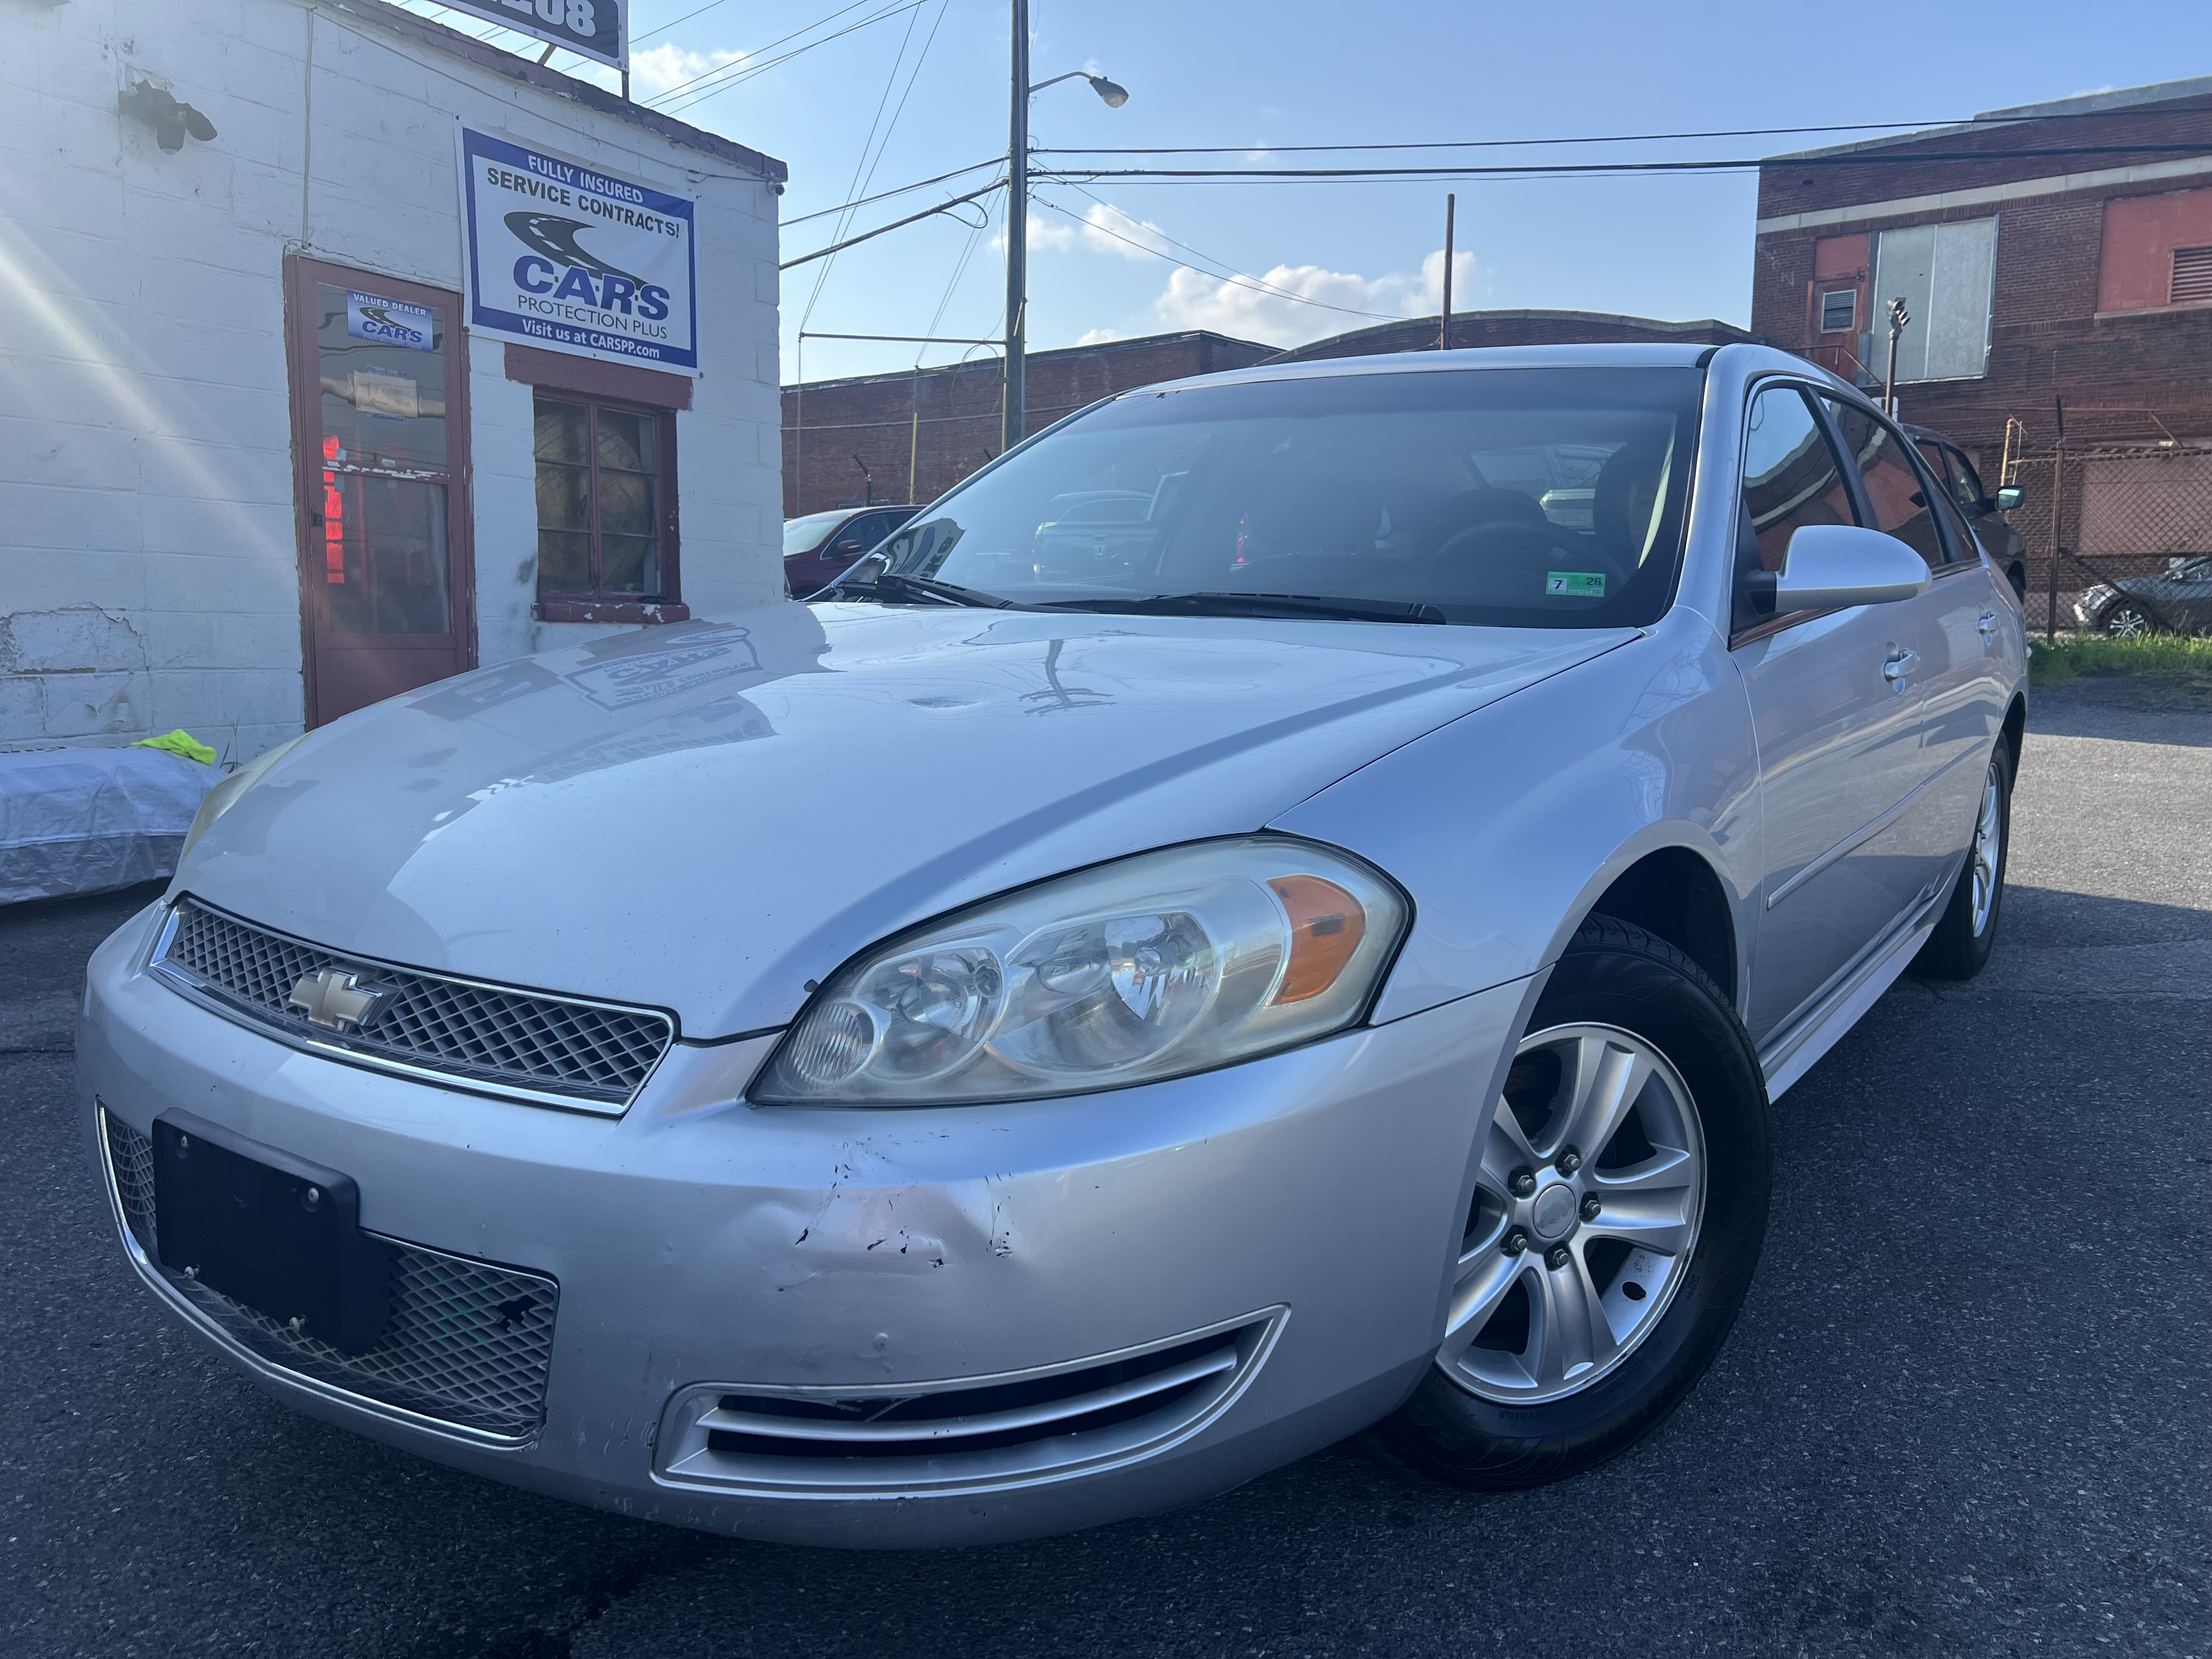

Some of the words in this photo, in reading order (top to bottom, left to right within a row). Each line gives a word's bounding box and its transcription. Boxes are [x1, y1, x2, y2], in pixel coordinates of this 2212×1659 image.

[528, 155, 574, 183] FULLY
[580, 172, 644, 204] INSURED
[487, 167, 571, 206] SERVICE
[578, 195, 680, 238] CONTRACTS!
[353, 294, 389, 308] VALUED
[392, 303, 427, 317] DEALER
[518, 295, 628, 331] PROTECTION
[633, 320, 667, 339] PLUS
[522, 319, 552, 338] Visit
[556, 329, 569, 341] us
[574, 331, 587, 345] at
[590, 333, 660, 359] CARSPP.com
[1554, 579, 1563, 589] 7
[1587, 577, 1602, 586] 26
